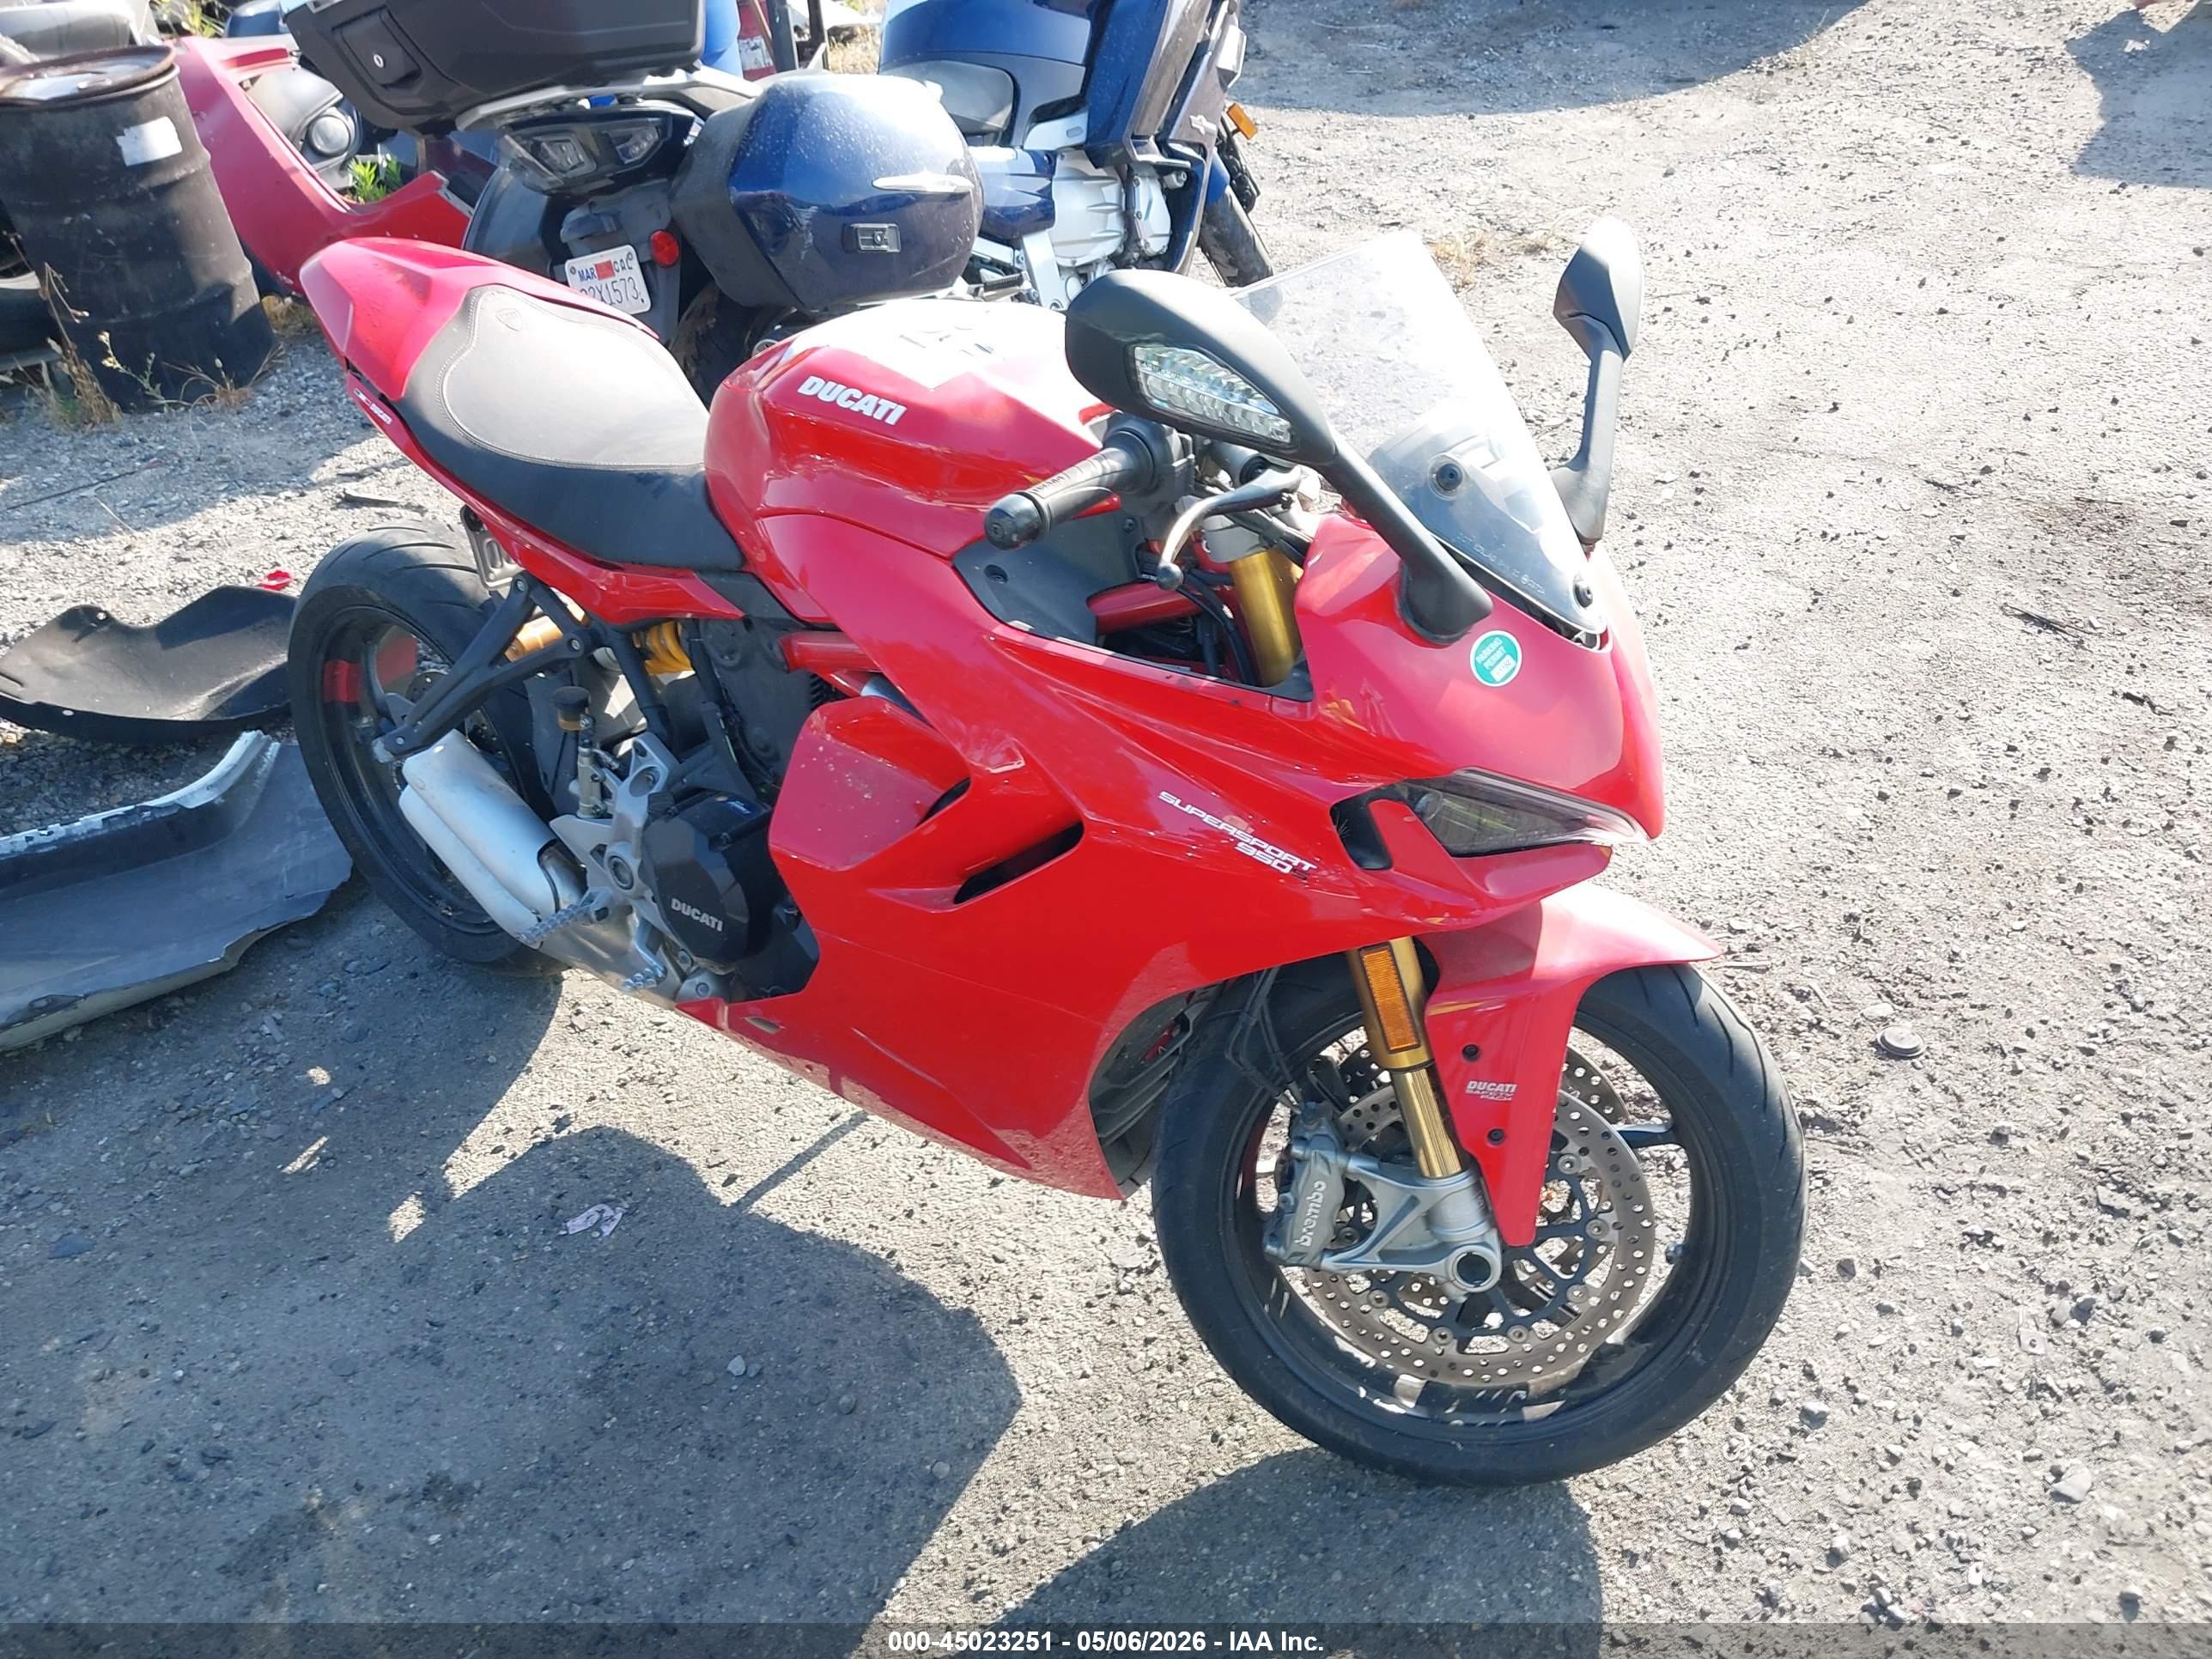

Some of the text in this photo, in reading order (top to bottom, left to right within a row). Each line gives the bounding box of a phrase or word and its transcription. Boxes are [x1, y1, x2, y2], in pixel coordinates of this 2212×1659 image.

[578, 267, 597, 283] MAR
[613, 258, 634, 273] CAL
[796, 375, 908, 426] DUCATI
[1475, 636, 1504, 665] PARKING
[1483, 645, 1507, 670] PERMIT
[1159, 791, 1317, 872] SUPERSPORT
[671, 897, 723, 933] DUCATI
[1466, 1080, 1518, 1093] DUCATI
[1293, 1180, 1328, 1247] brembo
